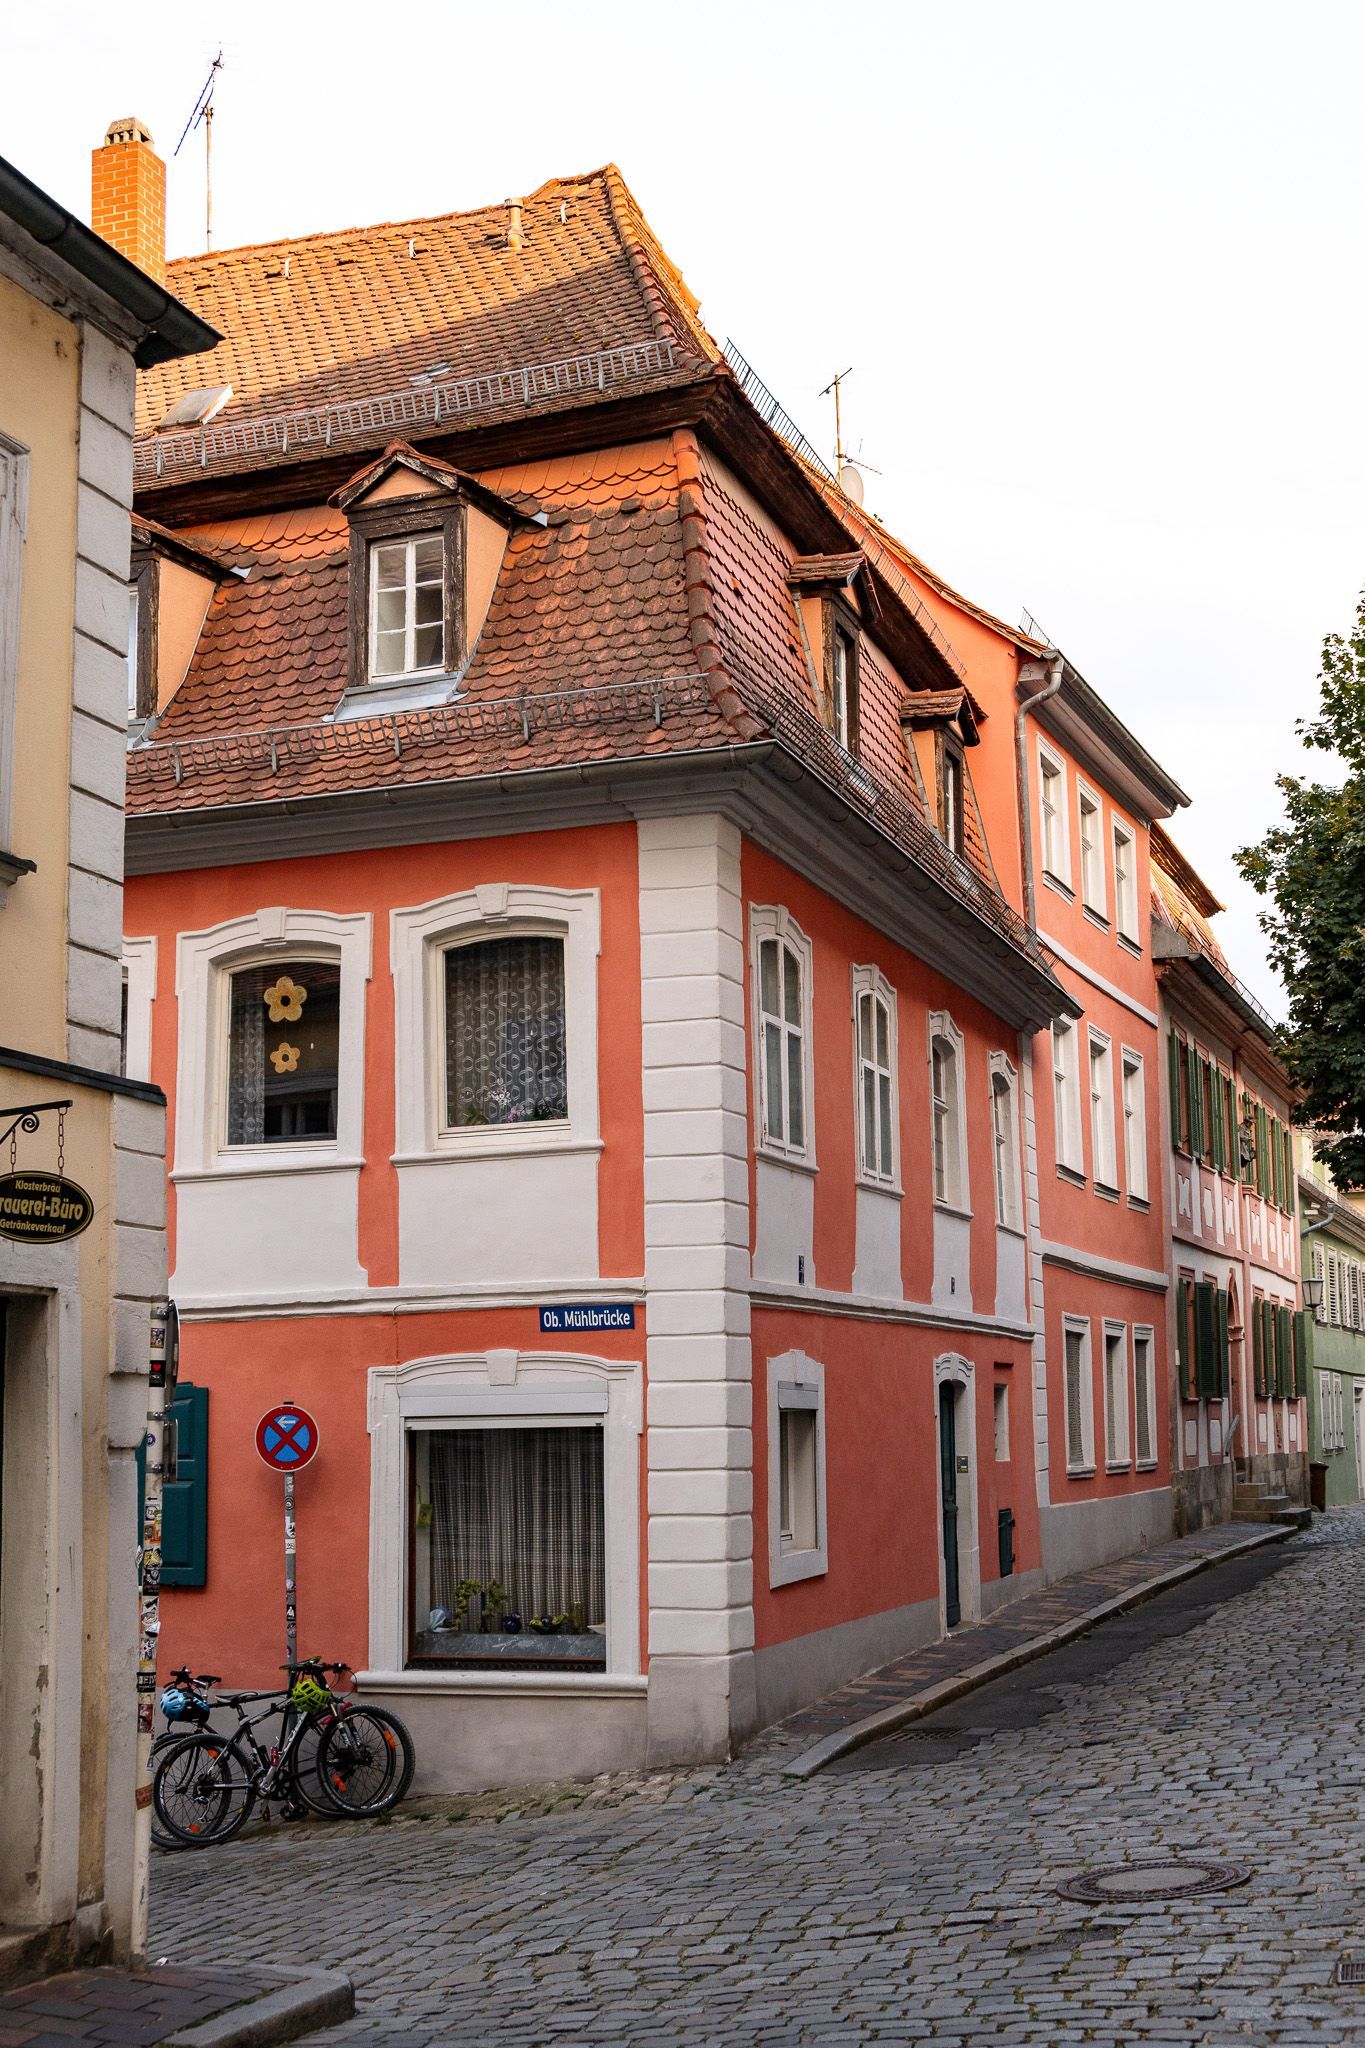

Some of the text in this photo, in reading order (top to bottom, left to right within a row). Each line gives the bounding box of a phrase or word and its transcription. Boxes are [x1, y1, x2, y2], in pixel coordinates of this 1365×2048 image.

[15, 1180, 61, 1193] Klosterbräu
[0, 1195, 84, 1220] rauerei-Büro
[0, 1218, 66, 1234] Getränkeverkauf
[543, 1309, 631, 1328] Ob. Mühlbrücke
